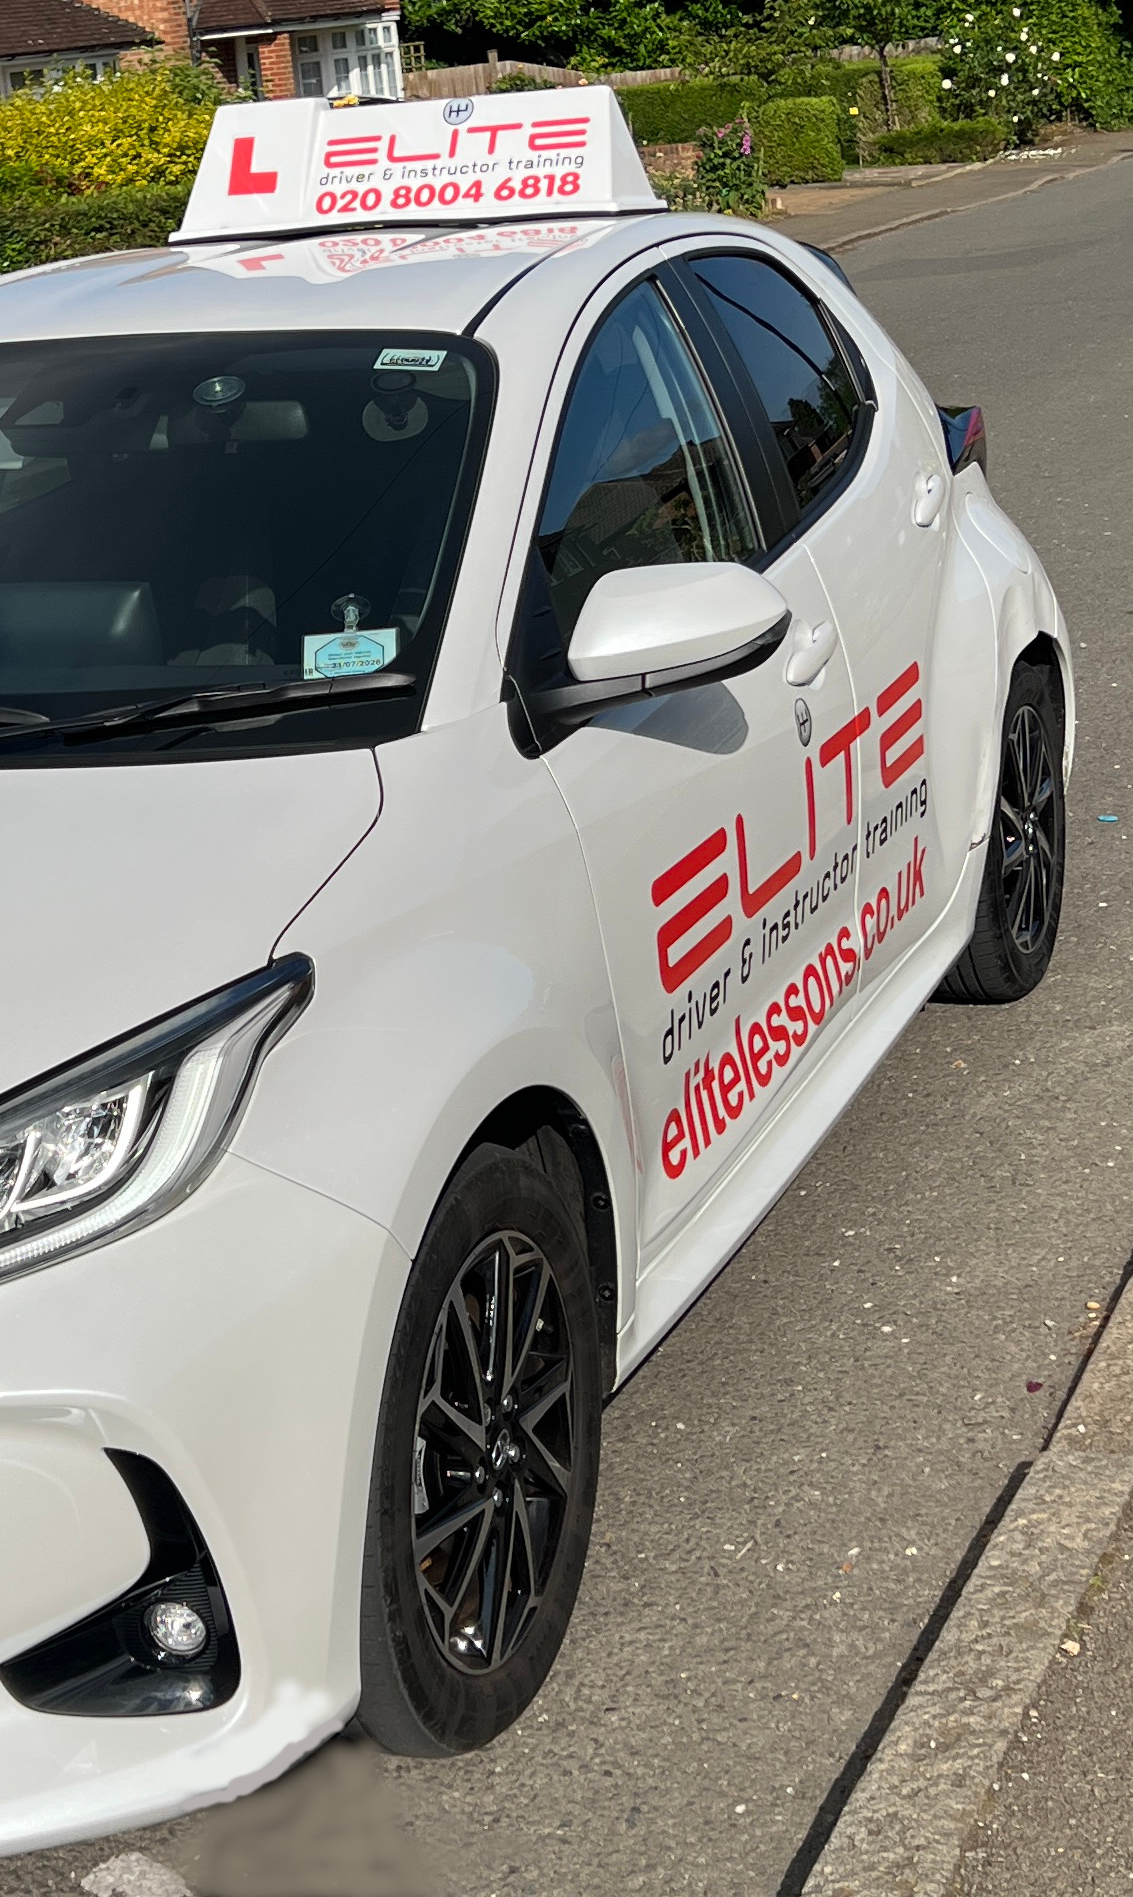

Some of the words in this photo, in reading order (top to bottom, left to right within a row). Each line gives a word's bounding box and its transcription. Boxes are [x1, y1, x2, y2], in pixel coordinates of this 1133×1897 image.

[228, 136, 279, 196] L
[319, 171, 375, 186] driver
[382, 167, 394, 181] &
[401, 160, 500, 179] instructor
[507, 152, 585, 171] training
[323, 117, 591, 169] ELITE
[315, 188, 382, 215] 020
[389, 178, 484, 209] 8004
[493, 171, 580, 201] 6818
[651, 660, 925, 994] ELITE
[662, 967, 732, 1066] driver
[740, 937, 754, 985] &
[761, 843, 858, 965] instructor
[865, 777, 928, 859] training
[661, 835, 927, 1180] elitelessons.co.uk
